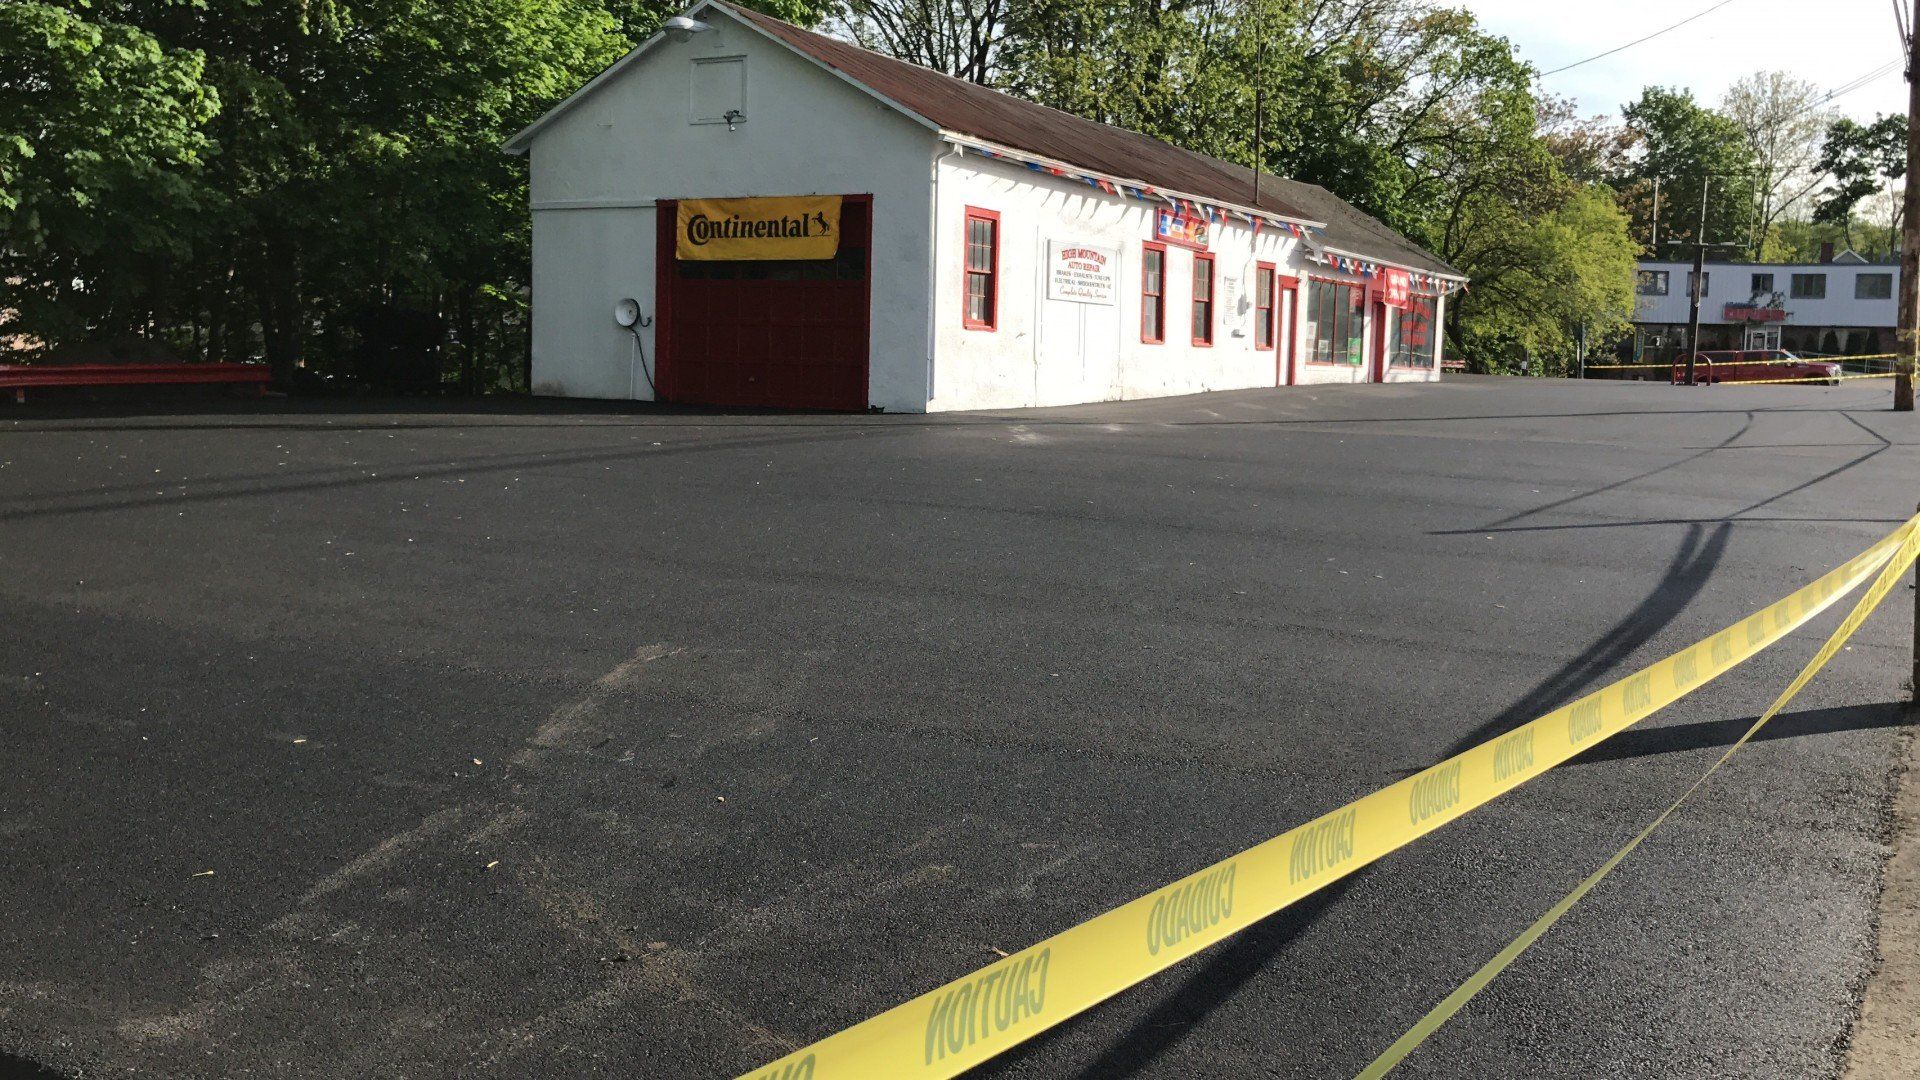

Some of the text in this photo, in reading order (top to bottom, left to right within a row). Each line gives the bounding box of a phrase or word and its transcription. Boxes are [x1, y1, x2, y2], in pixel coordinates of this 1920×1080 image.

[687, 213, 810, 246] Continental
[1068, 261, 1100, 272] AUTO REPAIR
[1060, 286, 1077, 296] Complete
[1077, 288, 1092, 298] Quality
